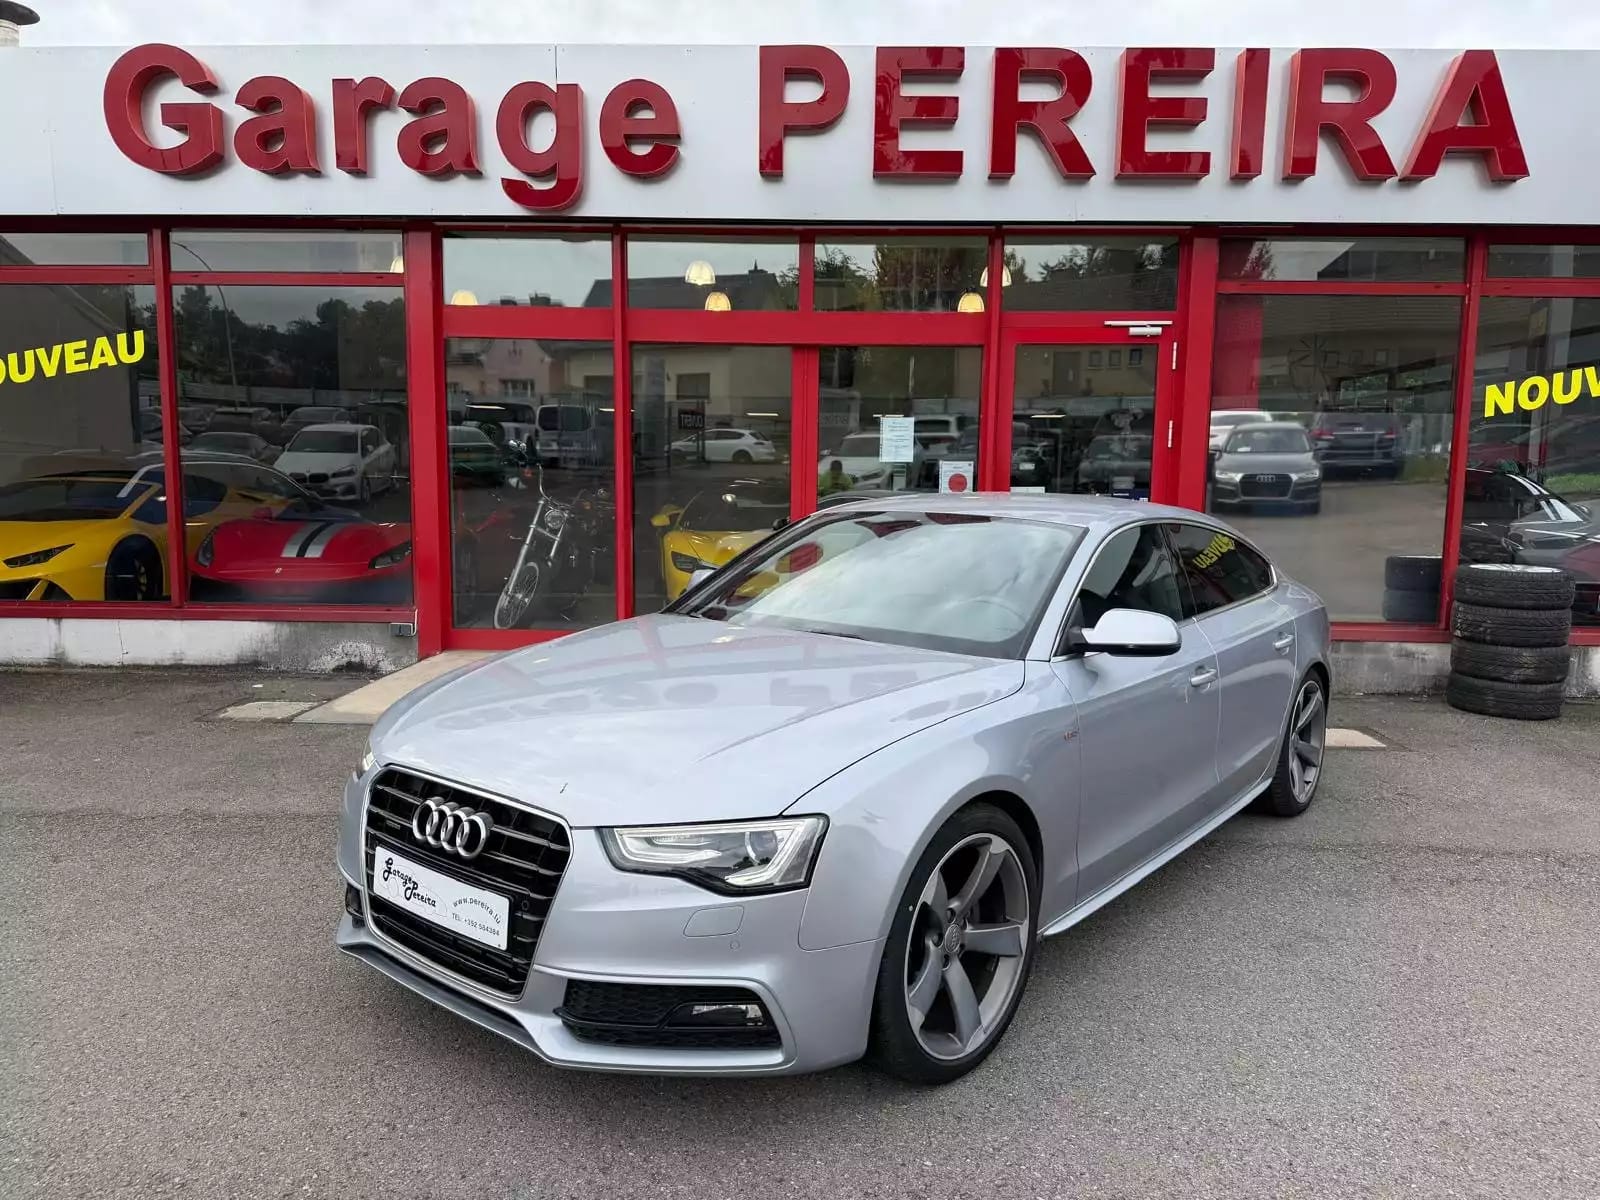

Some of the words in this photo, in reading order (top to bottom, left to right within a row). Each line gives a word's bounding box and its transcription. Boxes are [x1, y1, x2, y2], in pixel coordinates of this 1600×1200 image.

[103, 43, 682, 211] Garage
[759, 44, 1531, 183] PEREIRA
[0, 329, 145, 385] UVEAU
[383, 856, 412, 888] Garage
[404, 880, 436, 907] Pereira
[453, 897, 501, 924] www.pereira.lu
